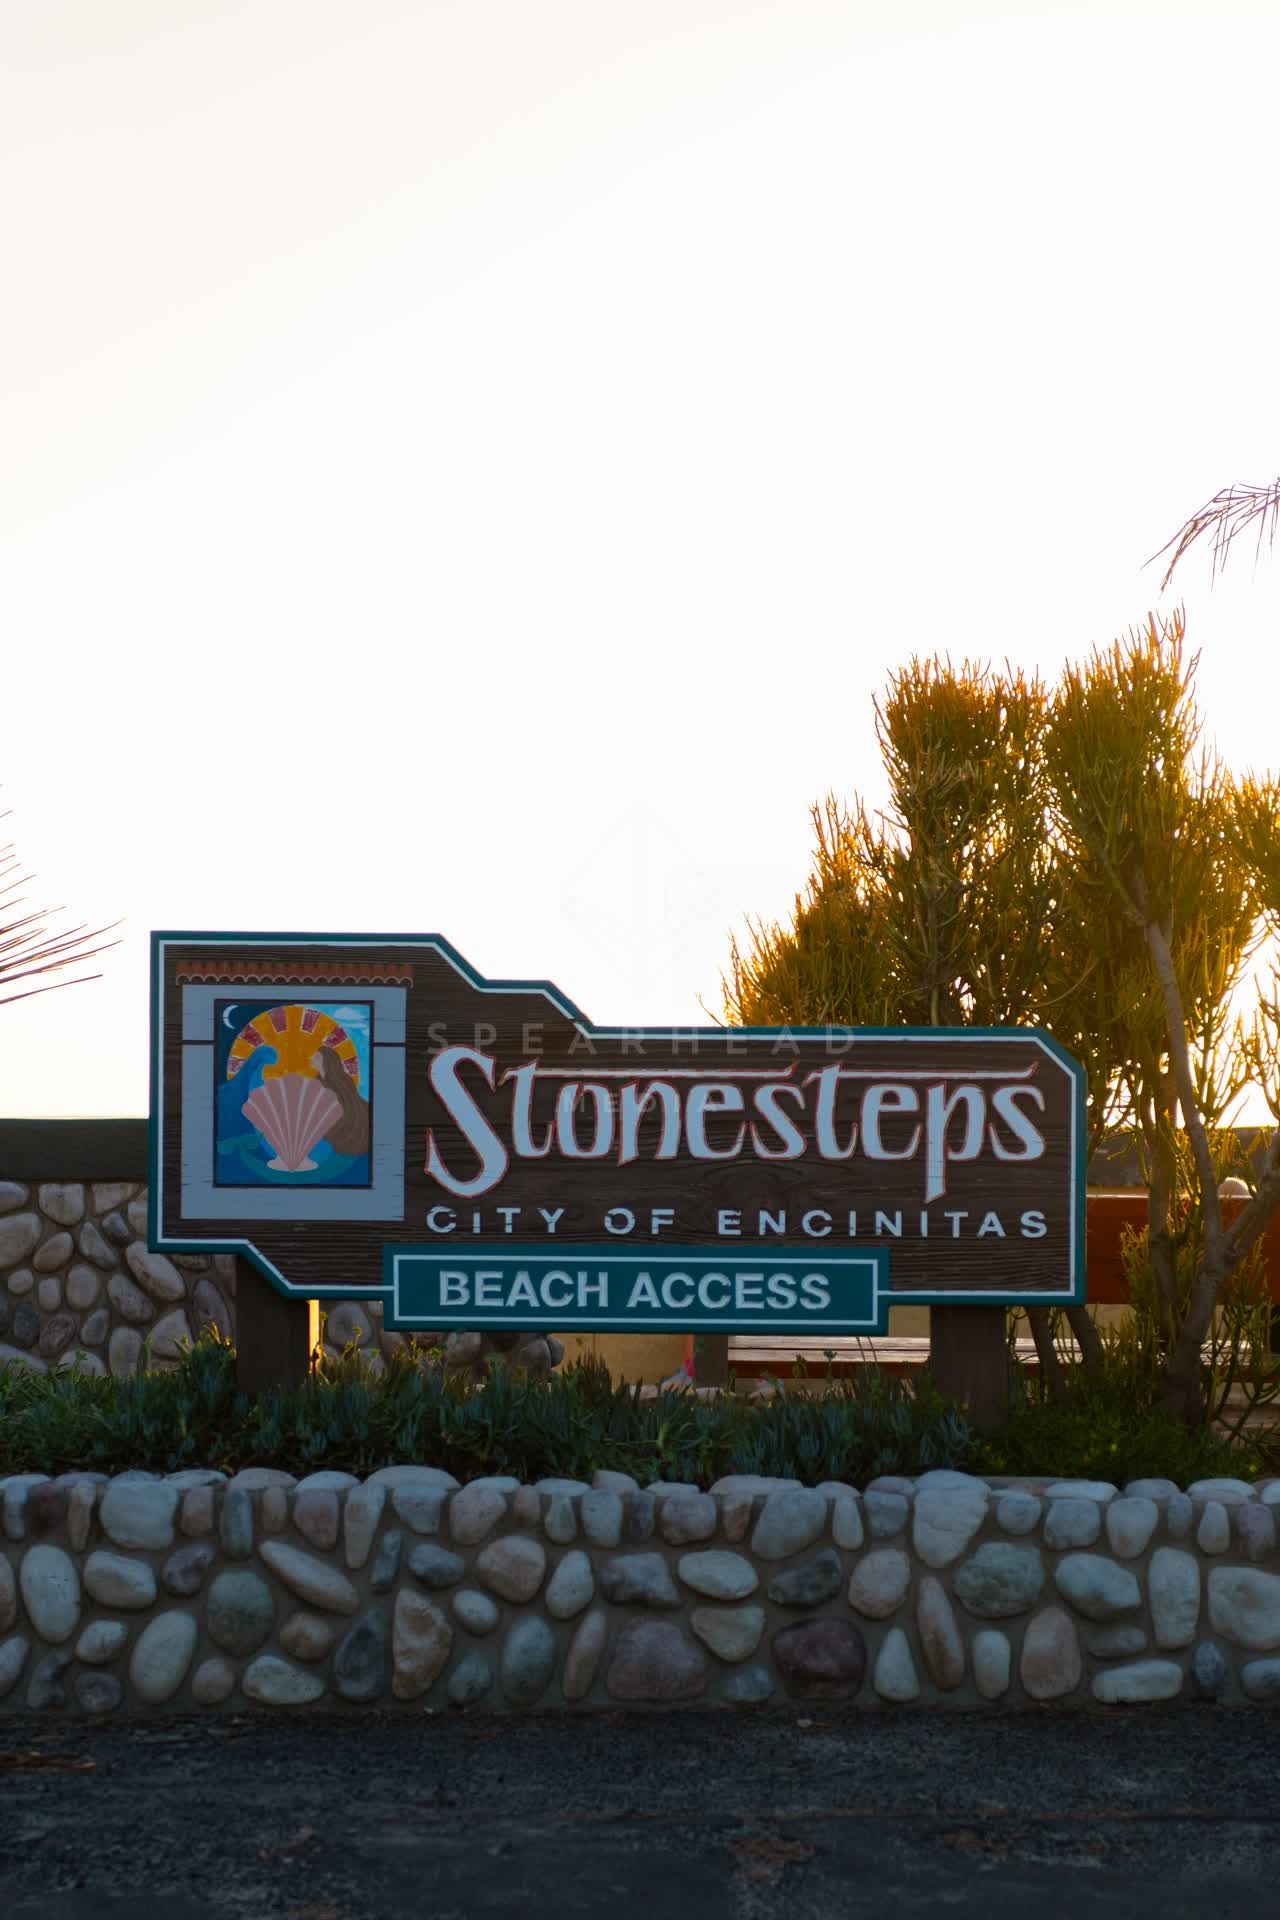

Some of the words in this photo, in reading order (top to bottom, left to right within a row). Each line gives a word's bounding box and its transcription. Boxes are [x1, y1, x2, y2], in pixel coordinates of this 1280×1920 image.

[424, 1044, 1047, 1203] Stonesteps
[426, 1206, 566, 1234] CITY
[604, 1208, 676, 1235] OF
[717, 1209, 1048, 1239] ENCINITAS
[439, 1269, 609, 1308] BEACH
[627, 1271, 832, 1310] ACCESS
